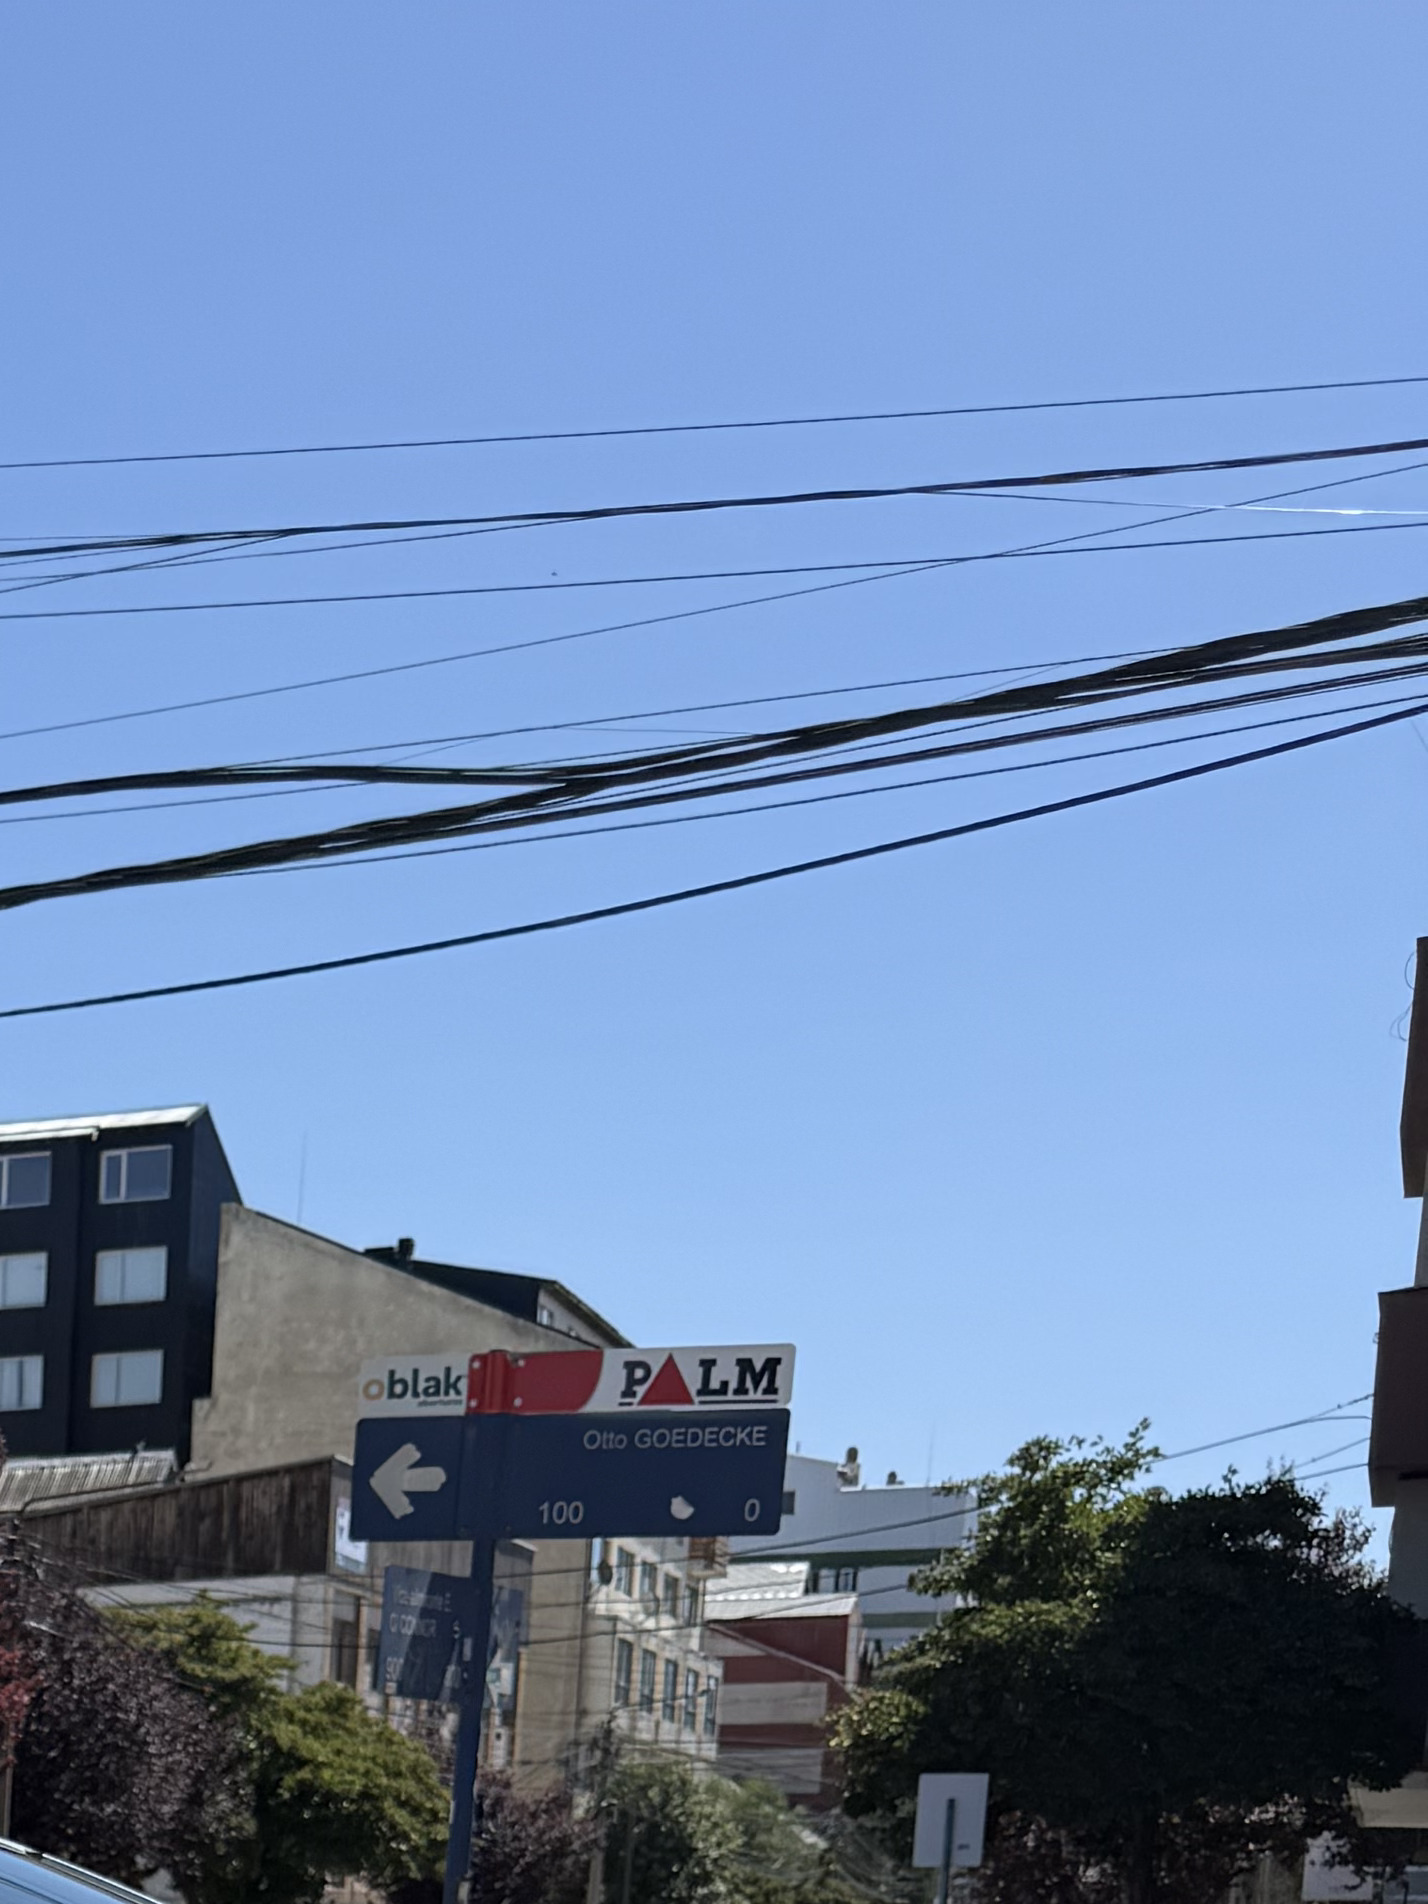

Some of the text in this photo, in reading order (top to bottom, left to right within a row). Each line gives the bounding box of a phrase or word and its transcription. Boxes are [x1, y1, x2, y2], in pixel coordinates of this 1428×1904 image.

[362, 1365, 466, 1401] oblak
[583, 1425, 768, 1450] Otto GOEDECKE
[538, 1500, 584, 1525] 100
[744, 1498, 761, 1522] 0
